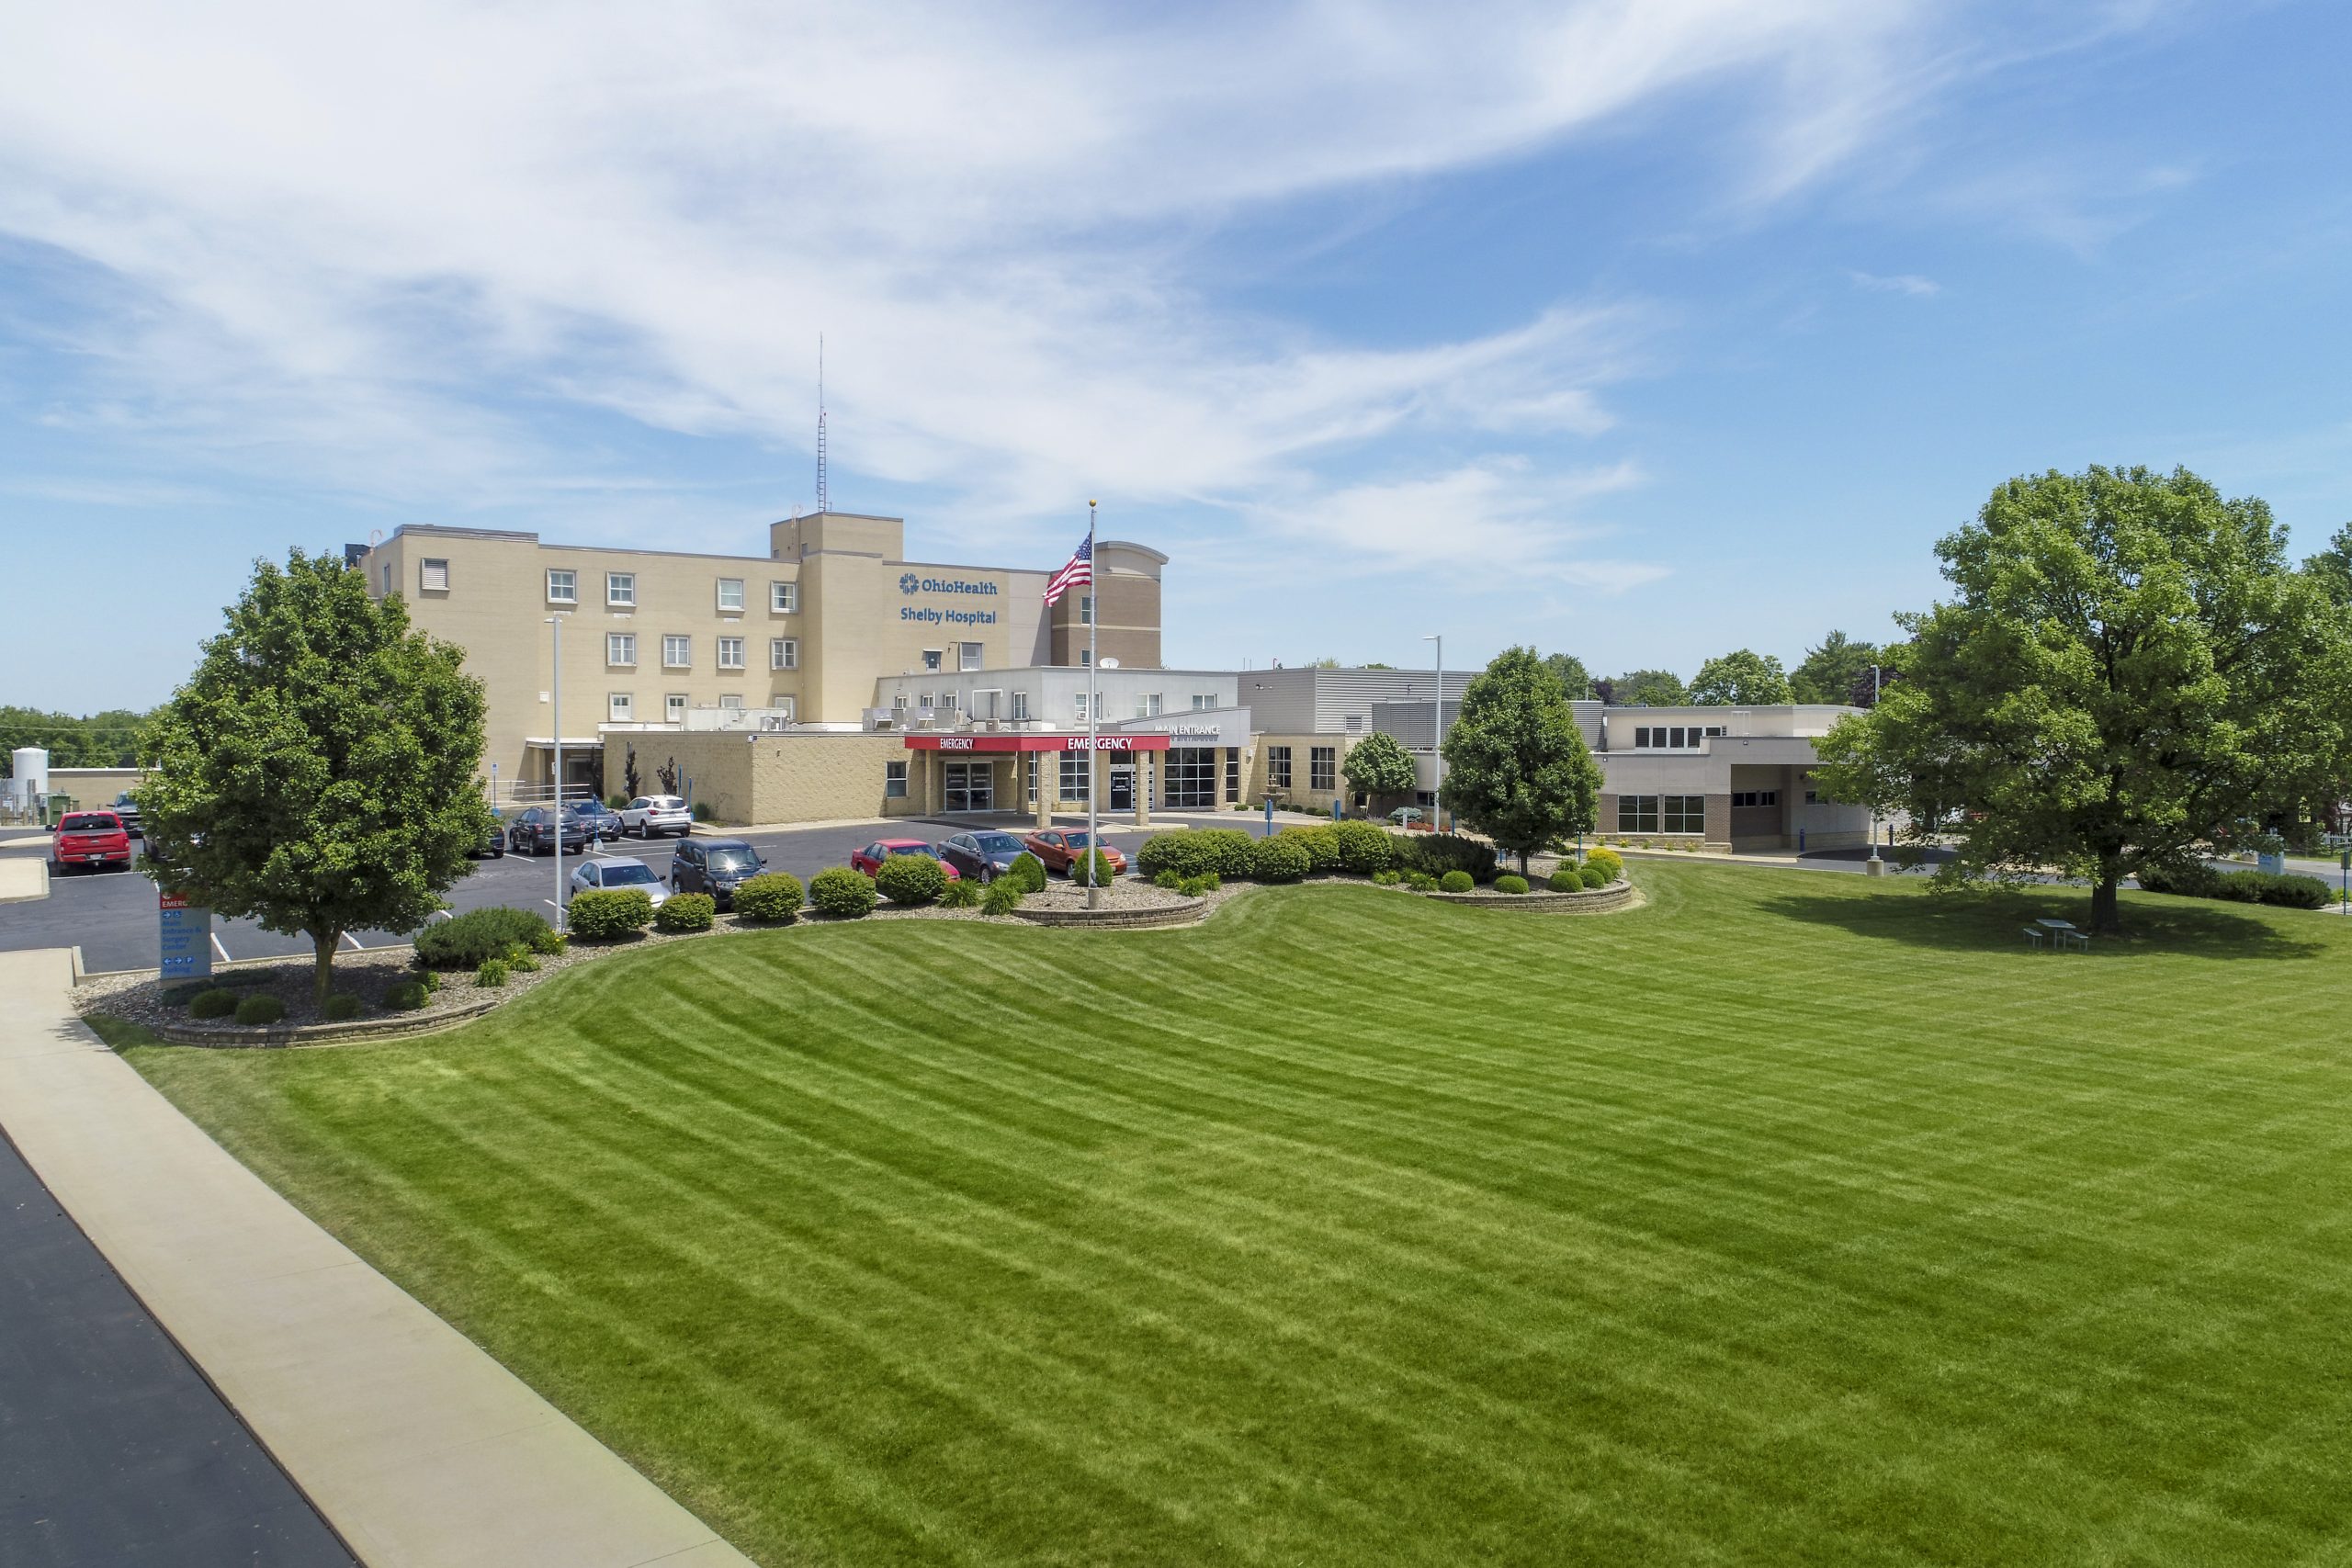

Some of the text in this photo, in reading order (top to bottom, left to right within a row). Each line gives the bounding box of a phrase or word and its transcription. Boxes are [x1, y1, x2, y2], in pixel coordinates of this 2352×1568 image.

[922, 579, 998, 595] OhioHealth
[900, 607, 996, 626] Shelby Hospital
[1179, 726, 1221, 735] ENTRANCE
[940, 738, 974, 750] EMERGENCY
[1068, 738, 1133, 750] EMEGENCY
